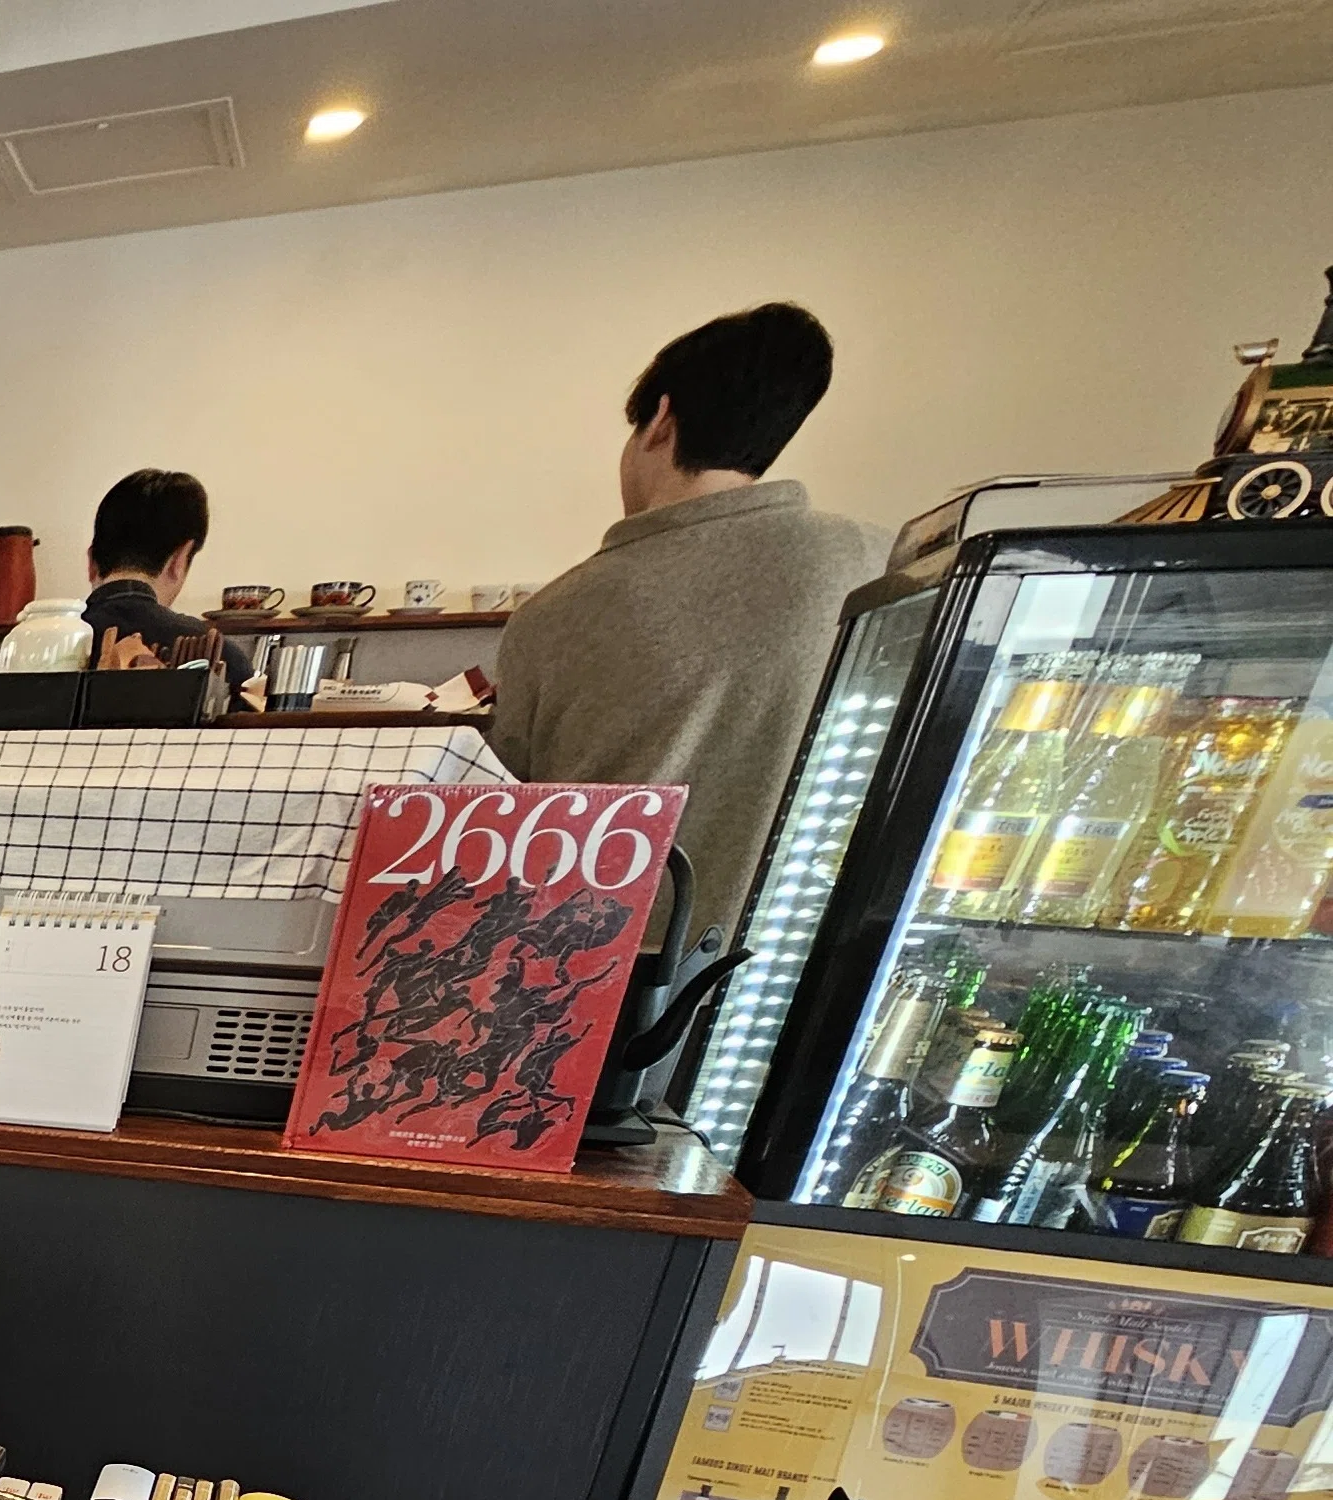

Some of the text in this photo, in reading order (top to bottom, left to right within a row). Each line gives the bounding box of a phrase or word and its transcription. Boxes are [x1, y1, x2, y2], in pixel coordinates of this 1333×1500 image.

[367, 789, 663, 889] 2666
[95, 945, 133, 973] 18
[1003, 1395, 1032, 1410] MAJOR
[753, 1466, 776, 1478] MALT
